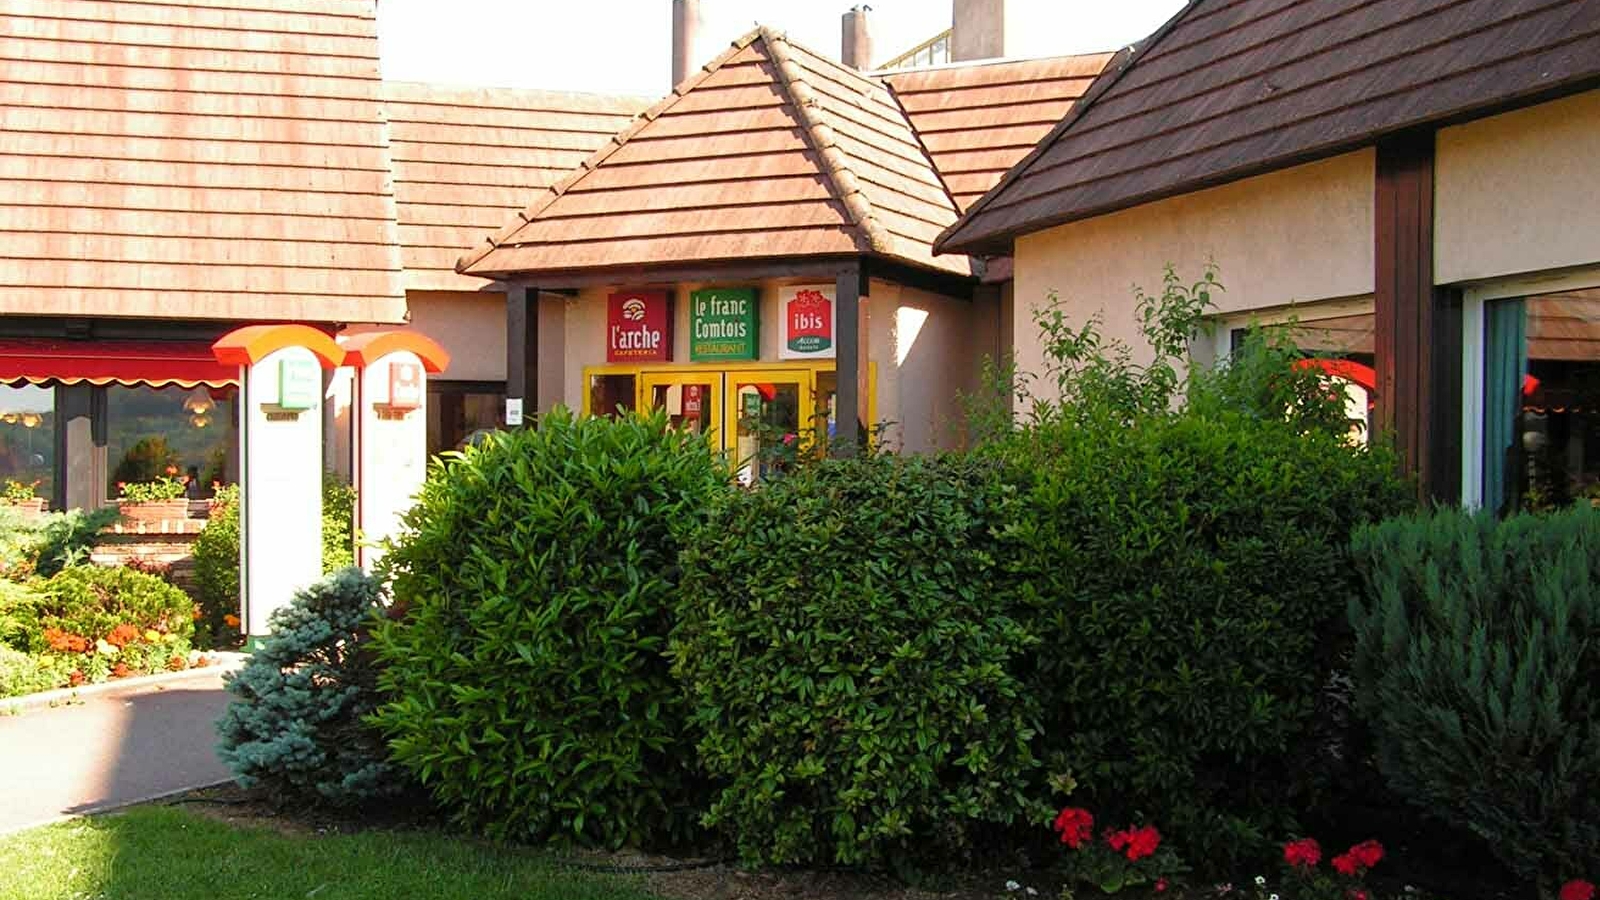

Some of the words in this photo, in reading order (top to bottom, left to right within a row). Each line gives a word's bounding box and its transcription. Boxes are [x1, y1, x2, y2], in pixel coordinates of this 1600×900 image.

[695, 296, 707, 317] le
[711, 295, 747, 316] franc
[695, 318, 747, 338] Comtois
[794, 313, 823, 330] ibis
[611, 324, 660, 349] l'arche
